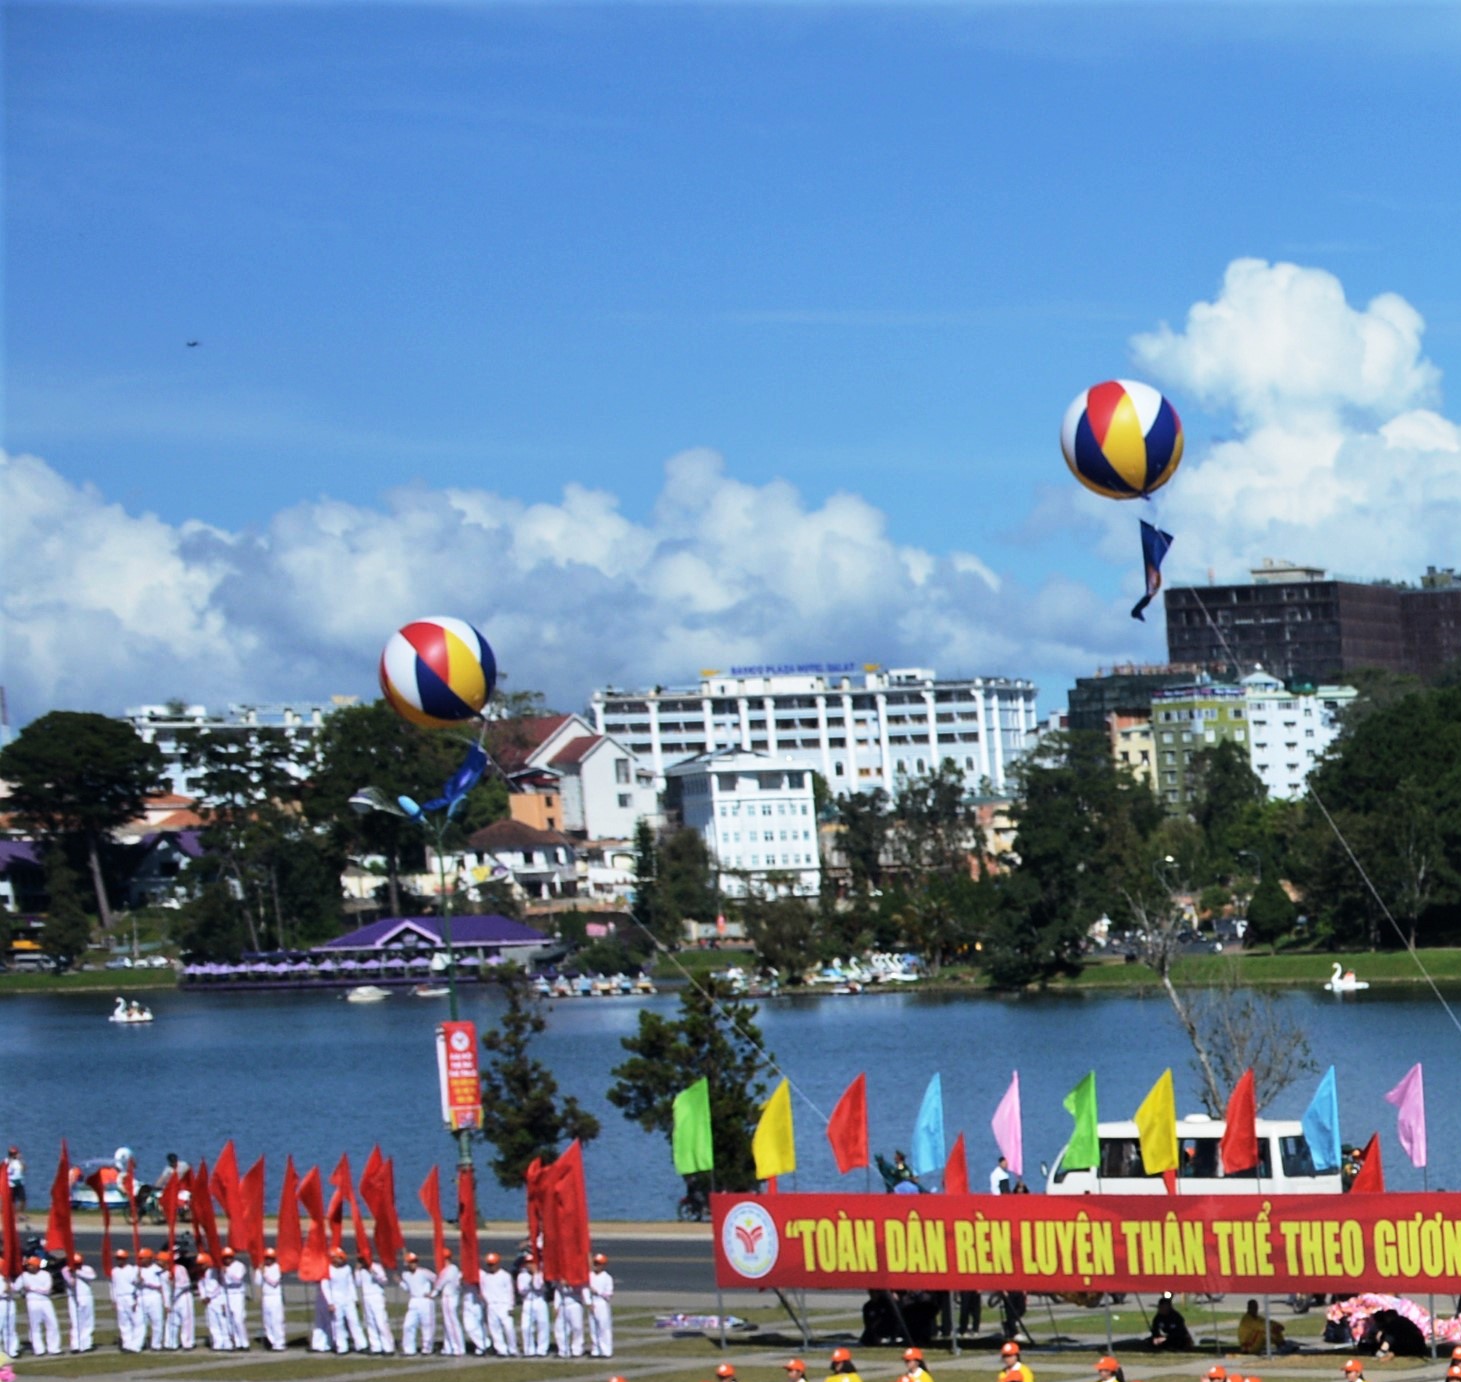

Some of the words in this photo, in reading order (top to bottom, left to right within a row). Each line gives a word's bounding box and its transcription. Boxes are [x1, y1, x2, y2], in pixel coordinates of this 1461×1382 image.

[785, 1210, 879, 1273] “TOÀN
[884, 1210, 948, 1274] DÂN
[953, 1210, 1014, 1275] RÈN
[1020, 1210, 1116, 1286] LUYỆN
[1121, 1210, 1207, 1277] THÂN
[1212, 1201, 1275, 1277] THỂ
[1280, 1219, 1364, 1278] THEO
